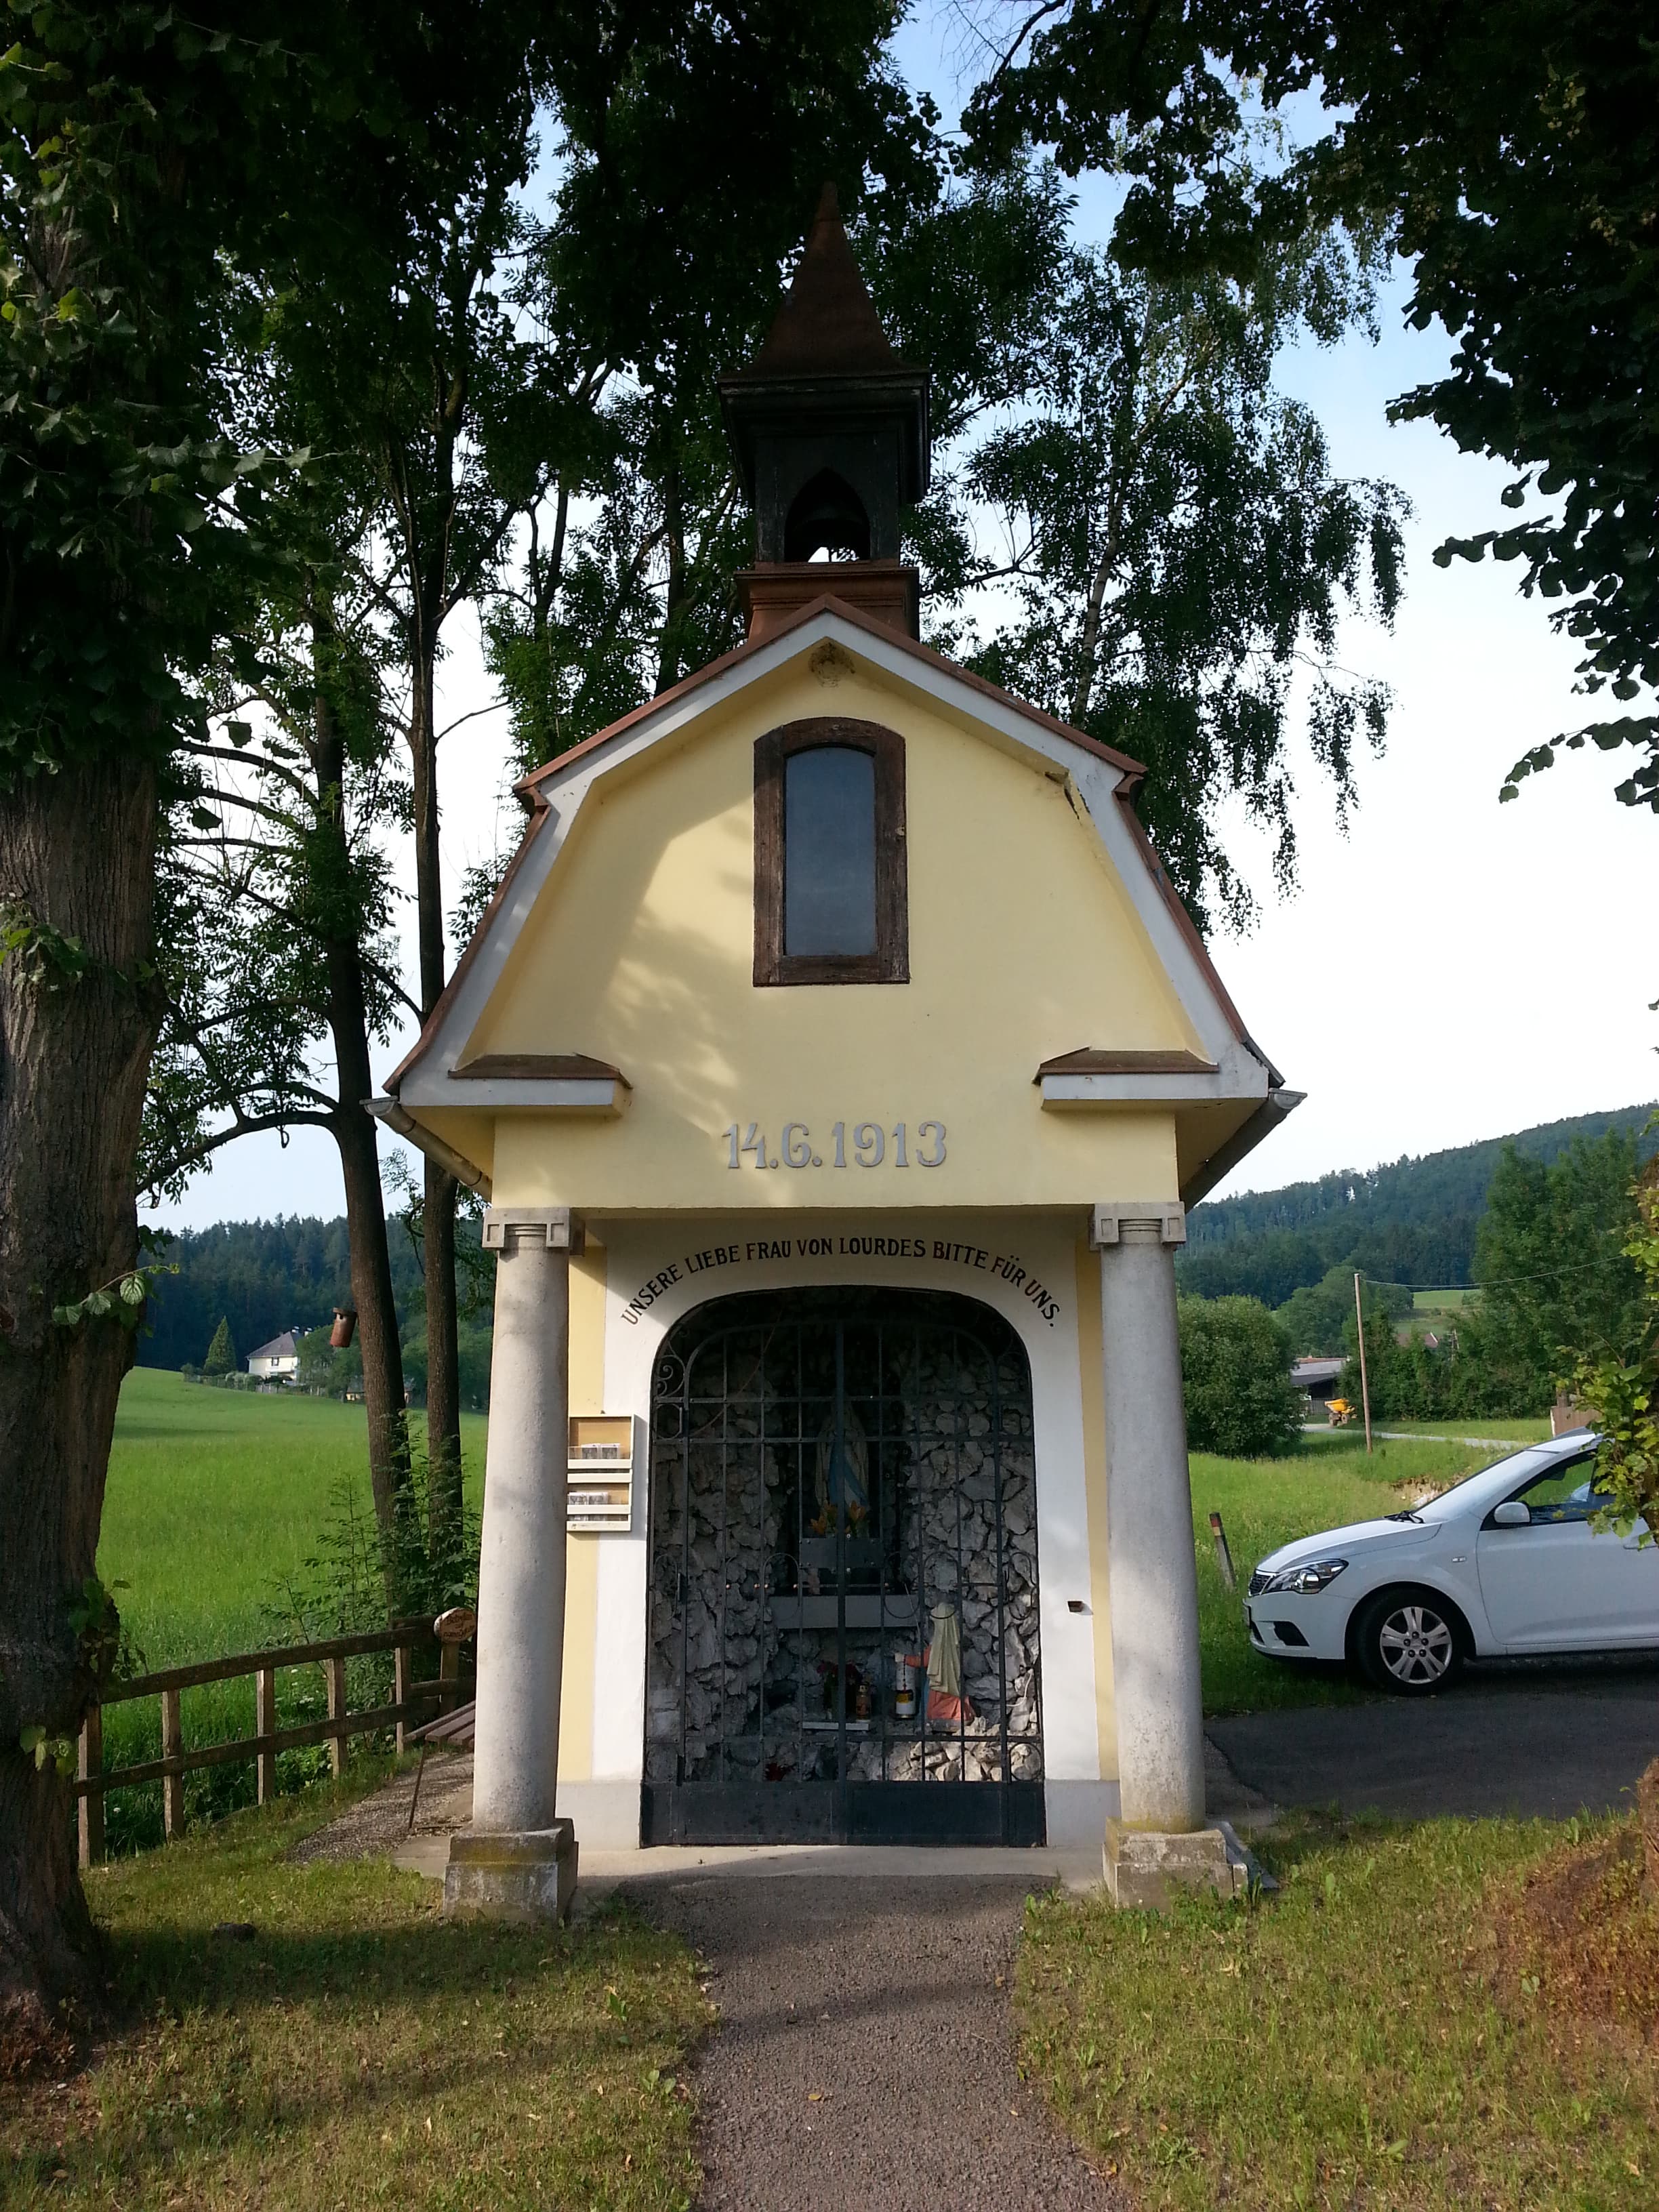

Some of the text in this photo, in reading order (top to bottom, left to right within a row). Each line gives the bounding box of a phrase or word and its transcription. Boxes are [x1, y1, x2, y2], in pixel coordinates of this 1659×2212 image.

[721, 1121, 947, 1169] 14.6.1913
[621, 1237, 1061, 1328] UNSERE LIEBE FRAU VON LOURDES BITTE FÜR UNS.
